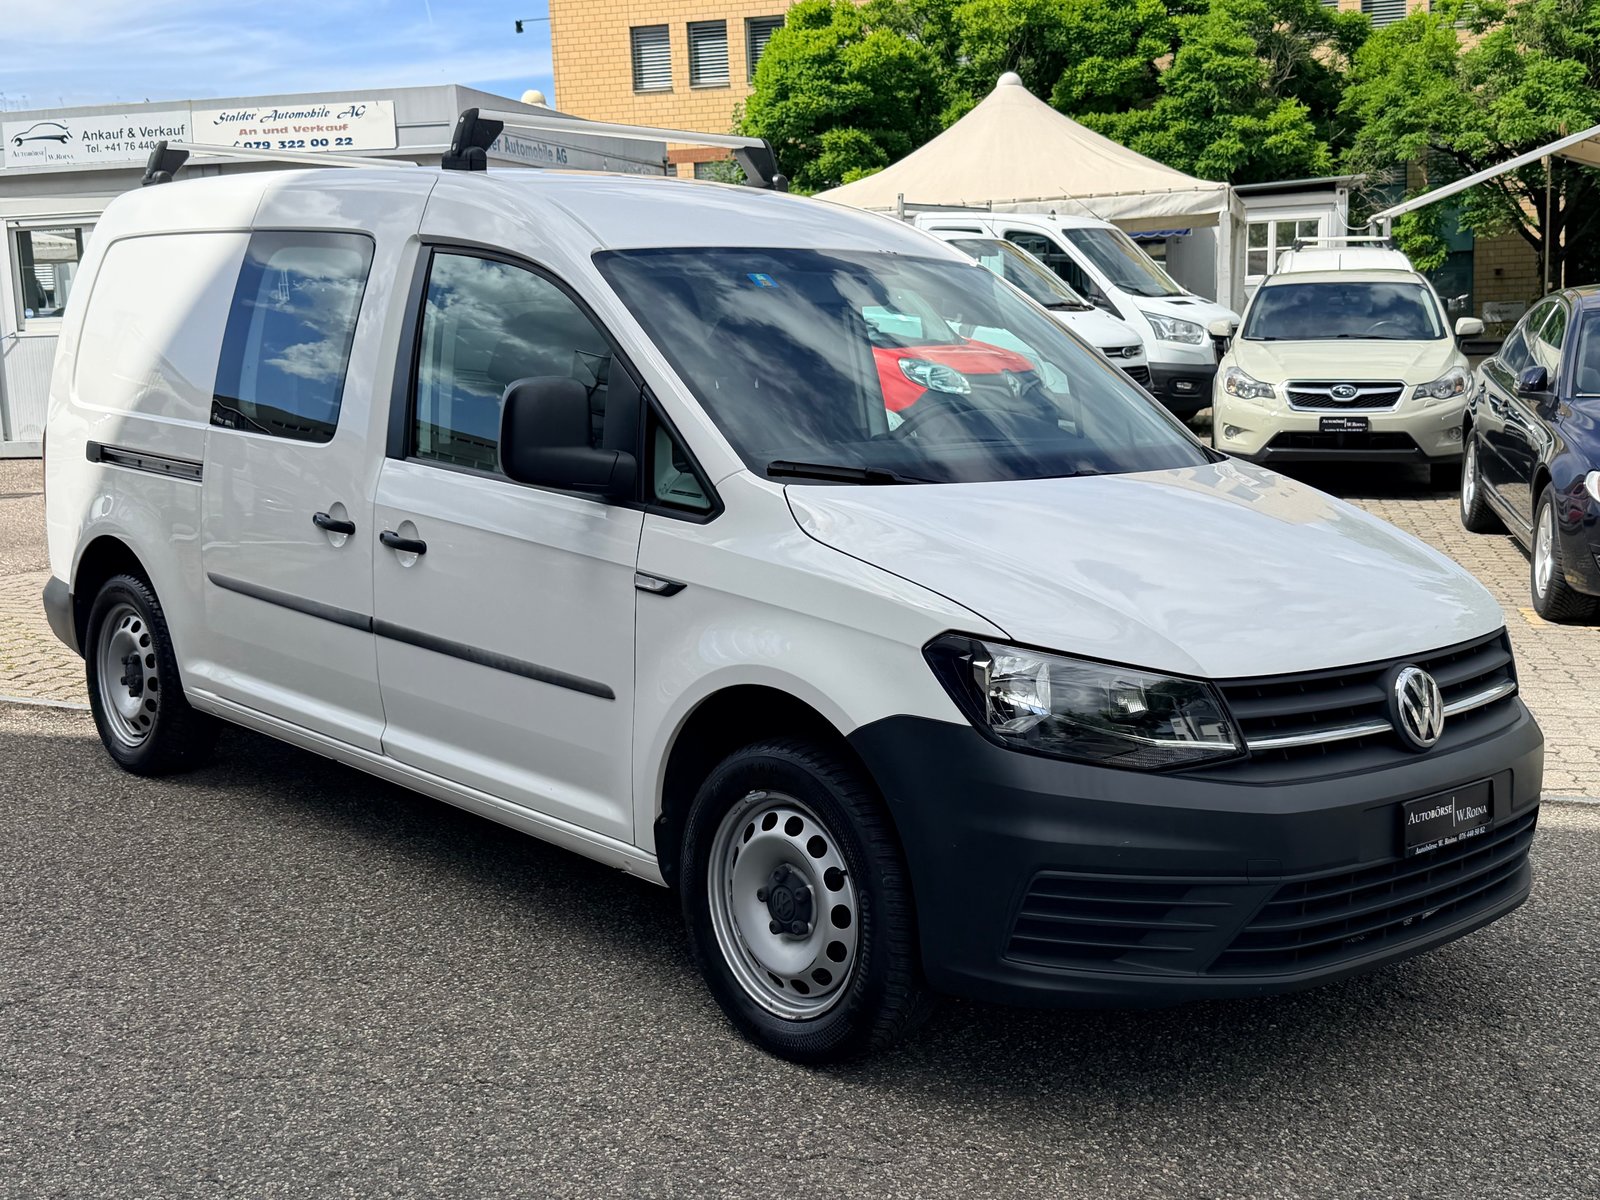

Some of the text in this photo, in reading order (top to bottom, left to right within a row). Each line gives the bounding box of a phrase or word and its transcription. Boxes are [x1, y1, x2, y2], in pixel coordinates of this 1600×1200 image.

[213, 105, 366, 125] Stalder Automobile AG
[81, 124, 186, 141] Ankauf & Verkauf
[239, 123, 349, 136] An und Verkauf
[85, 143, 102, 154] Tel.
[105, 142, 121, 152] +41
[125, 141, 136, 151] 76
[138, 140, 154, 150] 440
[278, 139, 305, 149] 322
[310, 138, 329, 147] 00
[335, 137, 353, 146] 22
[505, 136, 553, 161] Automobile
[556, 147, 568, 164] AG
